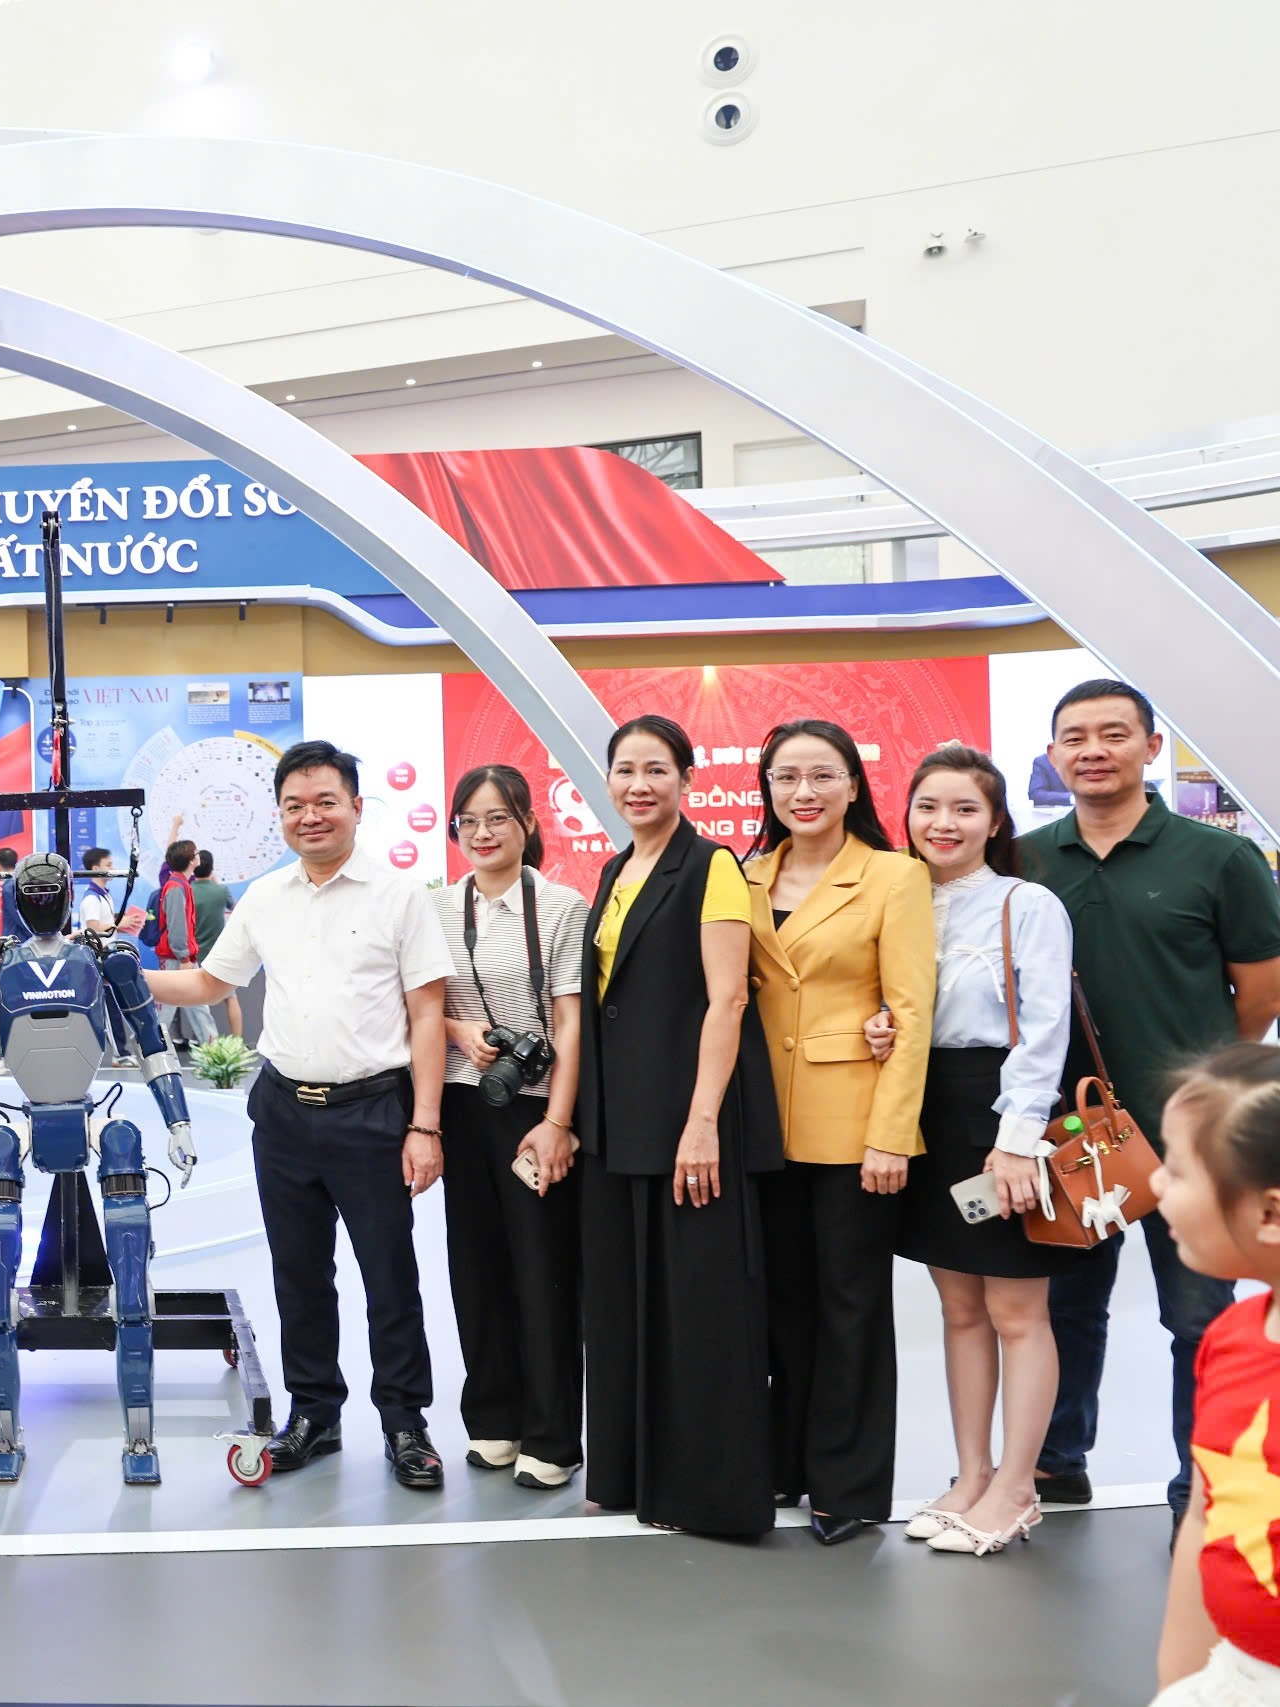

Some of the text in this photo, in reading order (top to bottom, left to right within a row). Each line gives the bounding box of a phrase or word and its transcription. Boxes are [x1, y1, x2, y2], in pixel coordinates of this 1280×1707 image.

[142, 473, 232, 520] ĐỔI
[60, 531, 198, 577] NƯỚC
[688, 785, 764, 808] ĐỒNG
[22, 988, 76, 1001] VINMOTION
